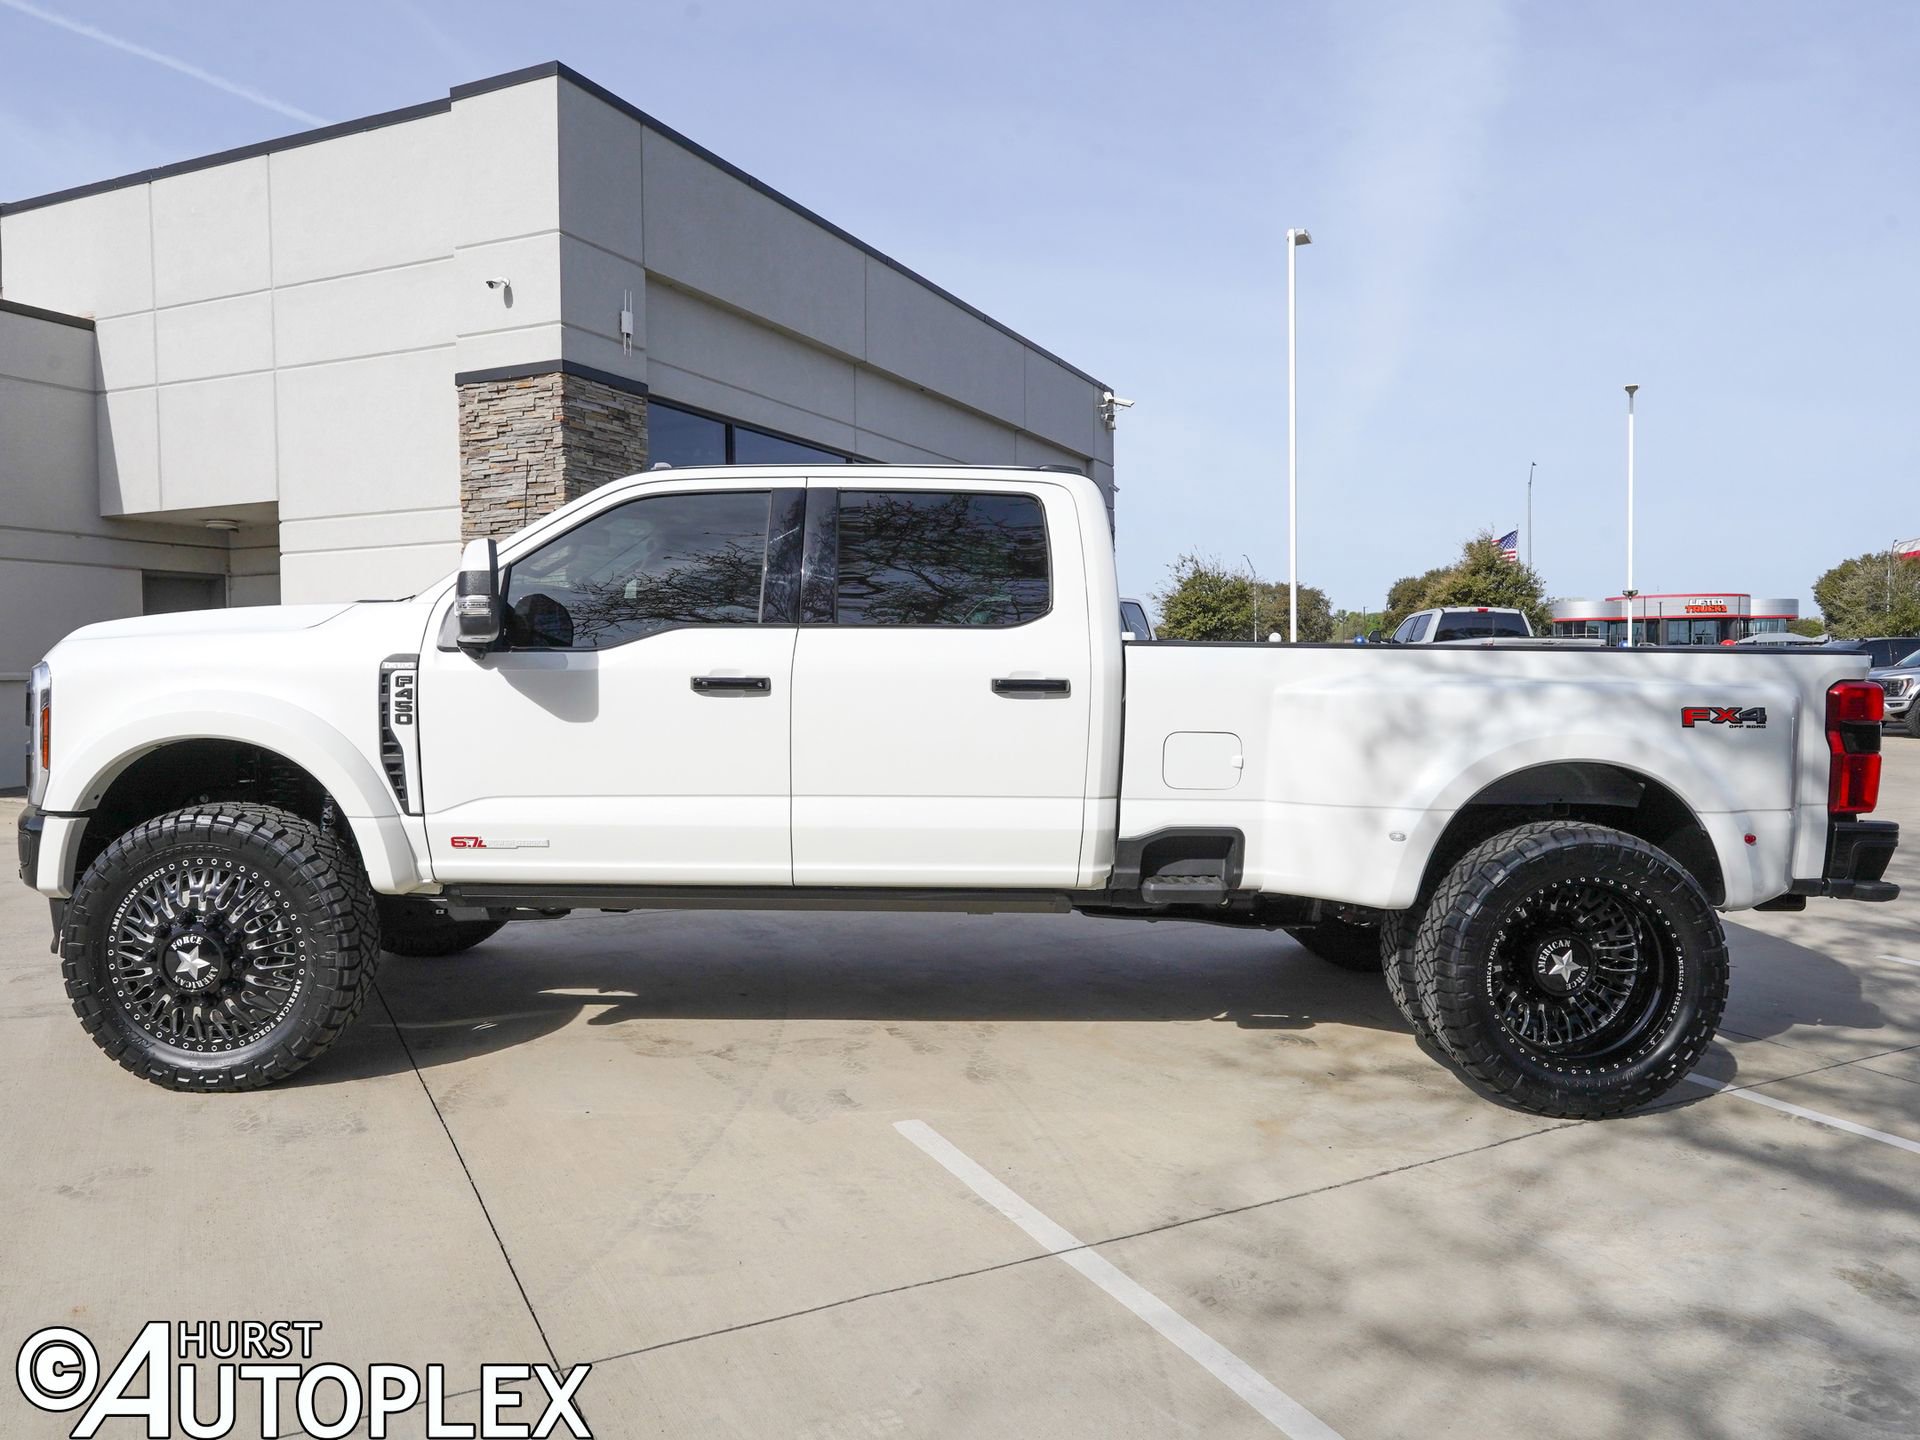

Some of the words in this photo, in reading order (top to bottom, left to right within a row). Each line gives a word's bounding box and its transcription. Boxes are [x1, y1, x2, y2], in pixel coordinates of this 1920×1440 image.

[1681, 707, 1767, 728] FX4
[451, 836, 487, 848] 6.7L
[170, 934, 204, 951] FORCE
[1537, 939, 1571, 975] AMERICAN
[172, 965, 219, 989] AMERICAN
